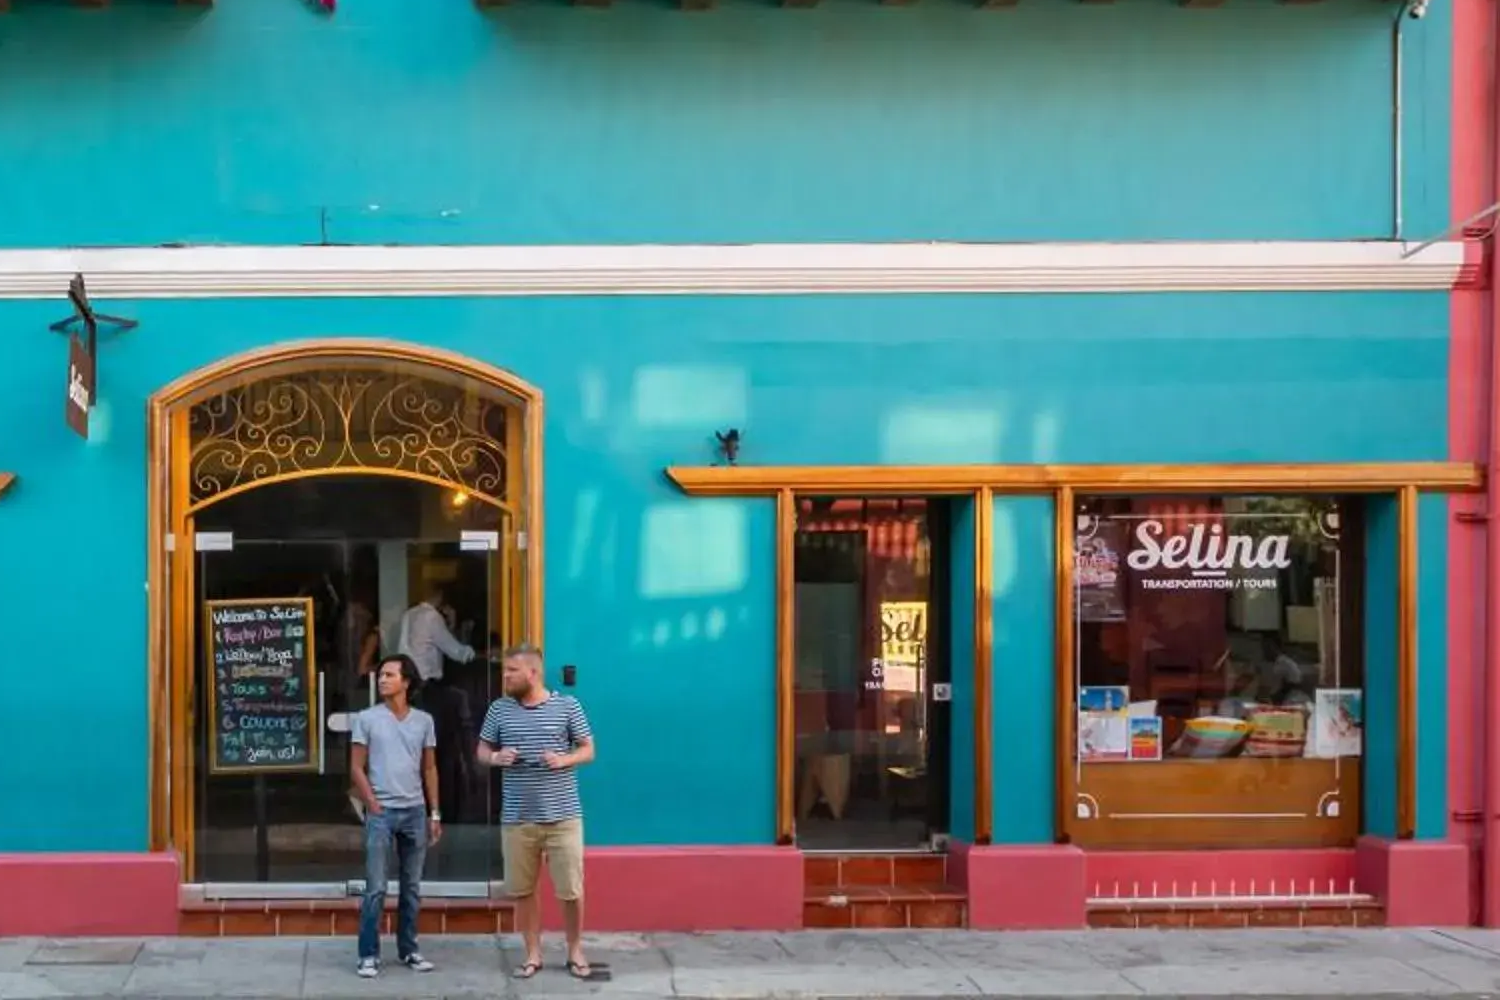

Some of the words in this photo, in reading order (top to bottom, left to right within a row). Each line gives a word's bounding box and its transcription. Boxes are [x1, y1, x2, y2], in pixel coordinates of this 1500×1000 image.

[1127, 519, 1291, 570] Selina
[1142, 578, 1233, 589] TRANSPORTATION
[1243, 578, 1277, 589] TOURS
